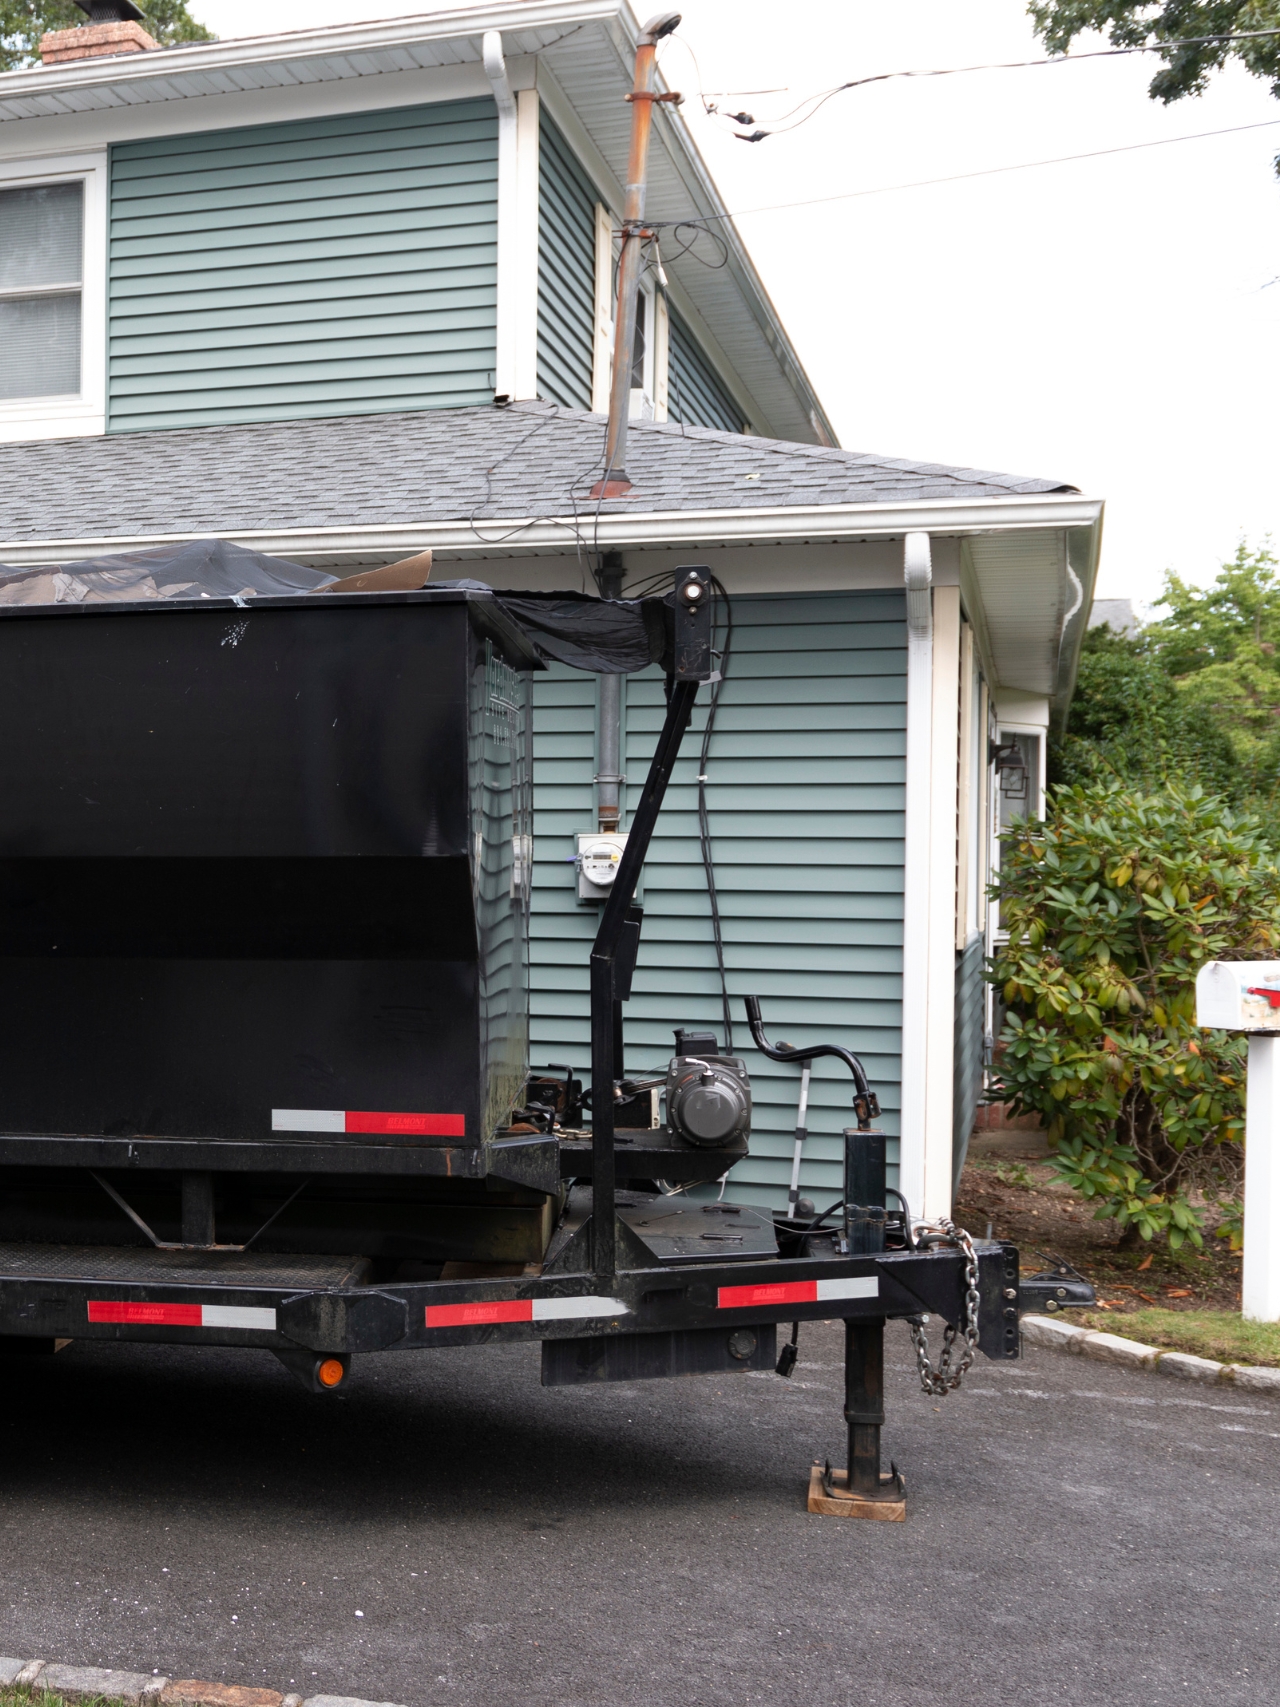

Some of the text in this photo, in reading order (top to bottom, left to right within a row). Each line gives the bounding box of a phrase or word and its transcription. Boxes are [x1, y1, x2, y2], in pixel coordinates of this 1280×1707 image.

[387, 1117, 426, 1125] BELMONT
[128, 1307, 166, 1315] BELMONT
[463, 1307, 499, 1315] BELMONT
